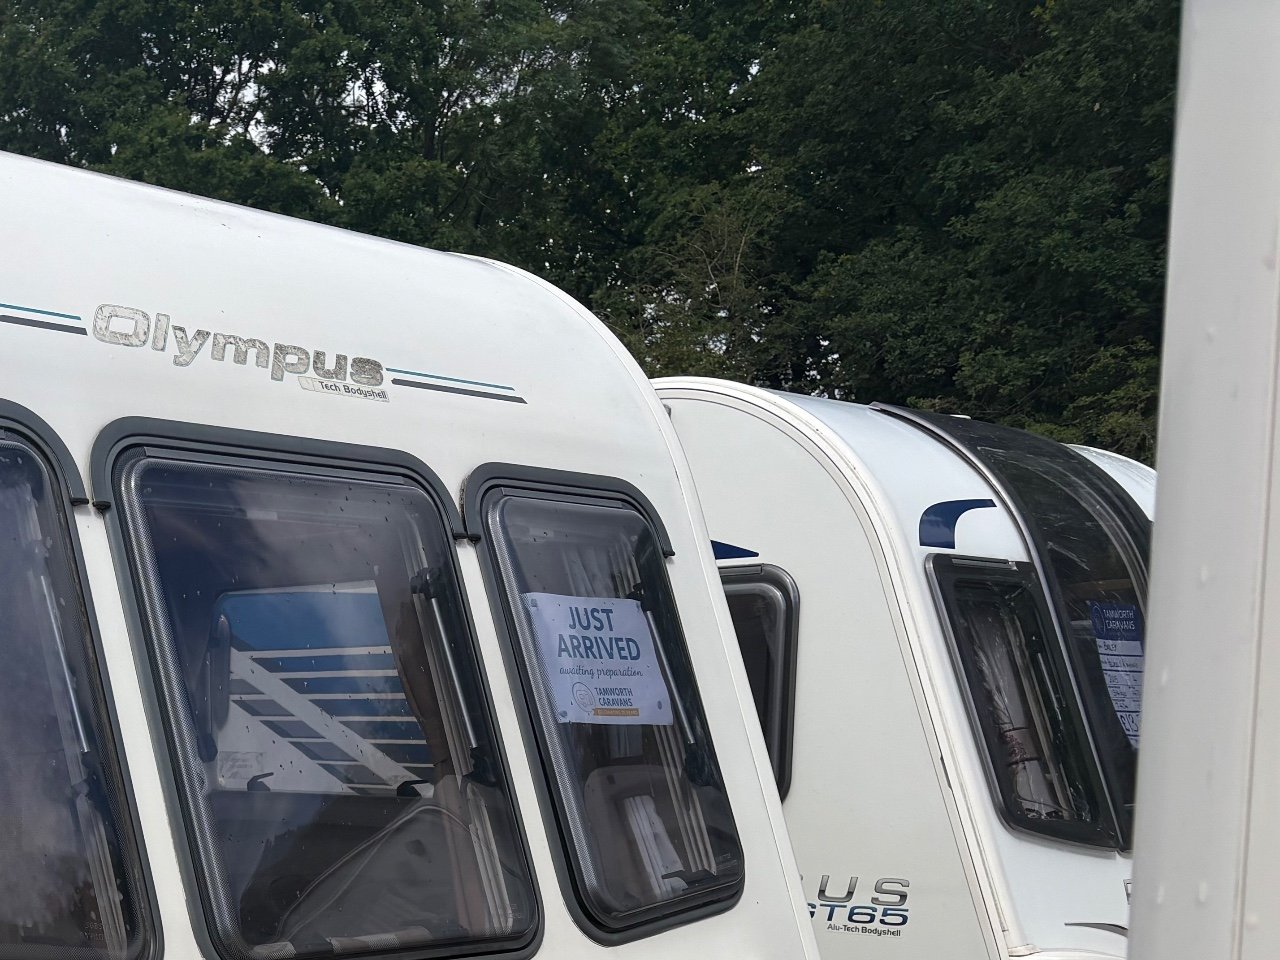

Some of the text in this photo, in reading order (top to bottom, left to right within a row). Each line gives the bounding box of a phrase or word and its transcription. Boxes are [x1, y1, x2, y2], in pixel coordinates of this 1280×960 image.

[92, 303, 384, 387] Olympus
[318, 381, 387, 400] Tech Bodyshell
[569, 607, 613, 631] JUST
[558, 634, 640, 661] ARRIVED
[560, 666, 643, 680] awaiting preparation
[594, 687, 633, 696] TAMWORTH
[599, 697, 633, 706] CARAVANS
[827, 923, 901, 937] Alu-Tech Bodyshell
